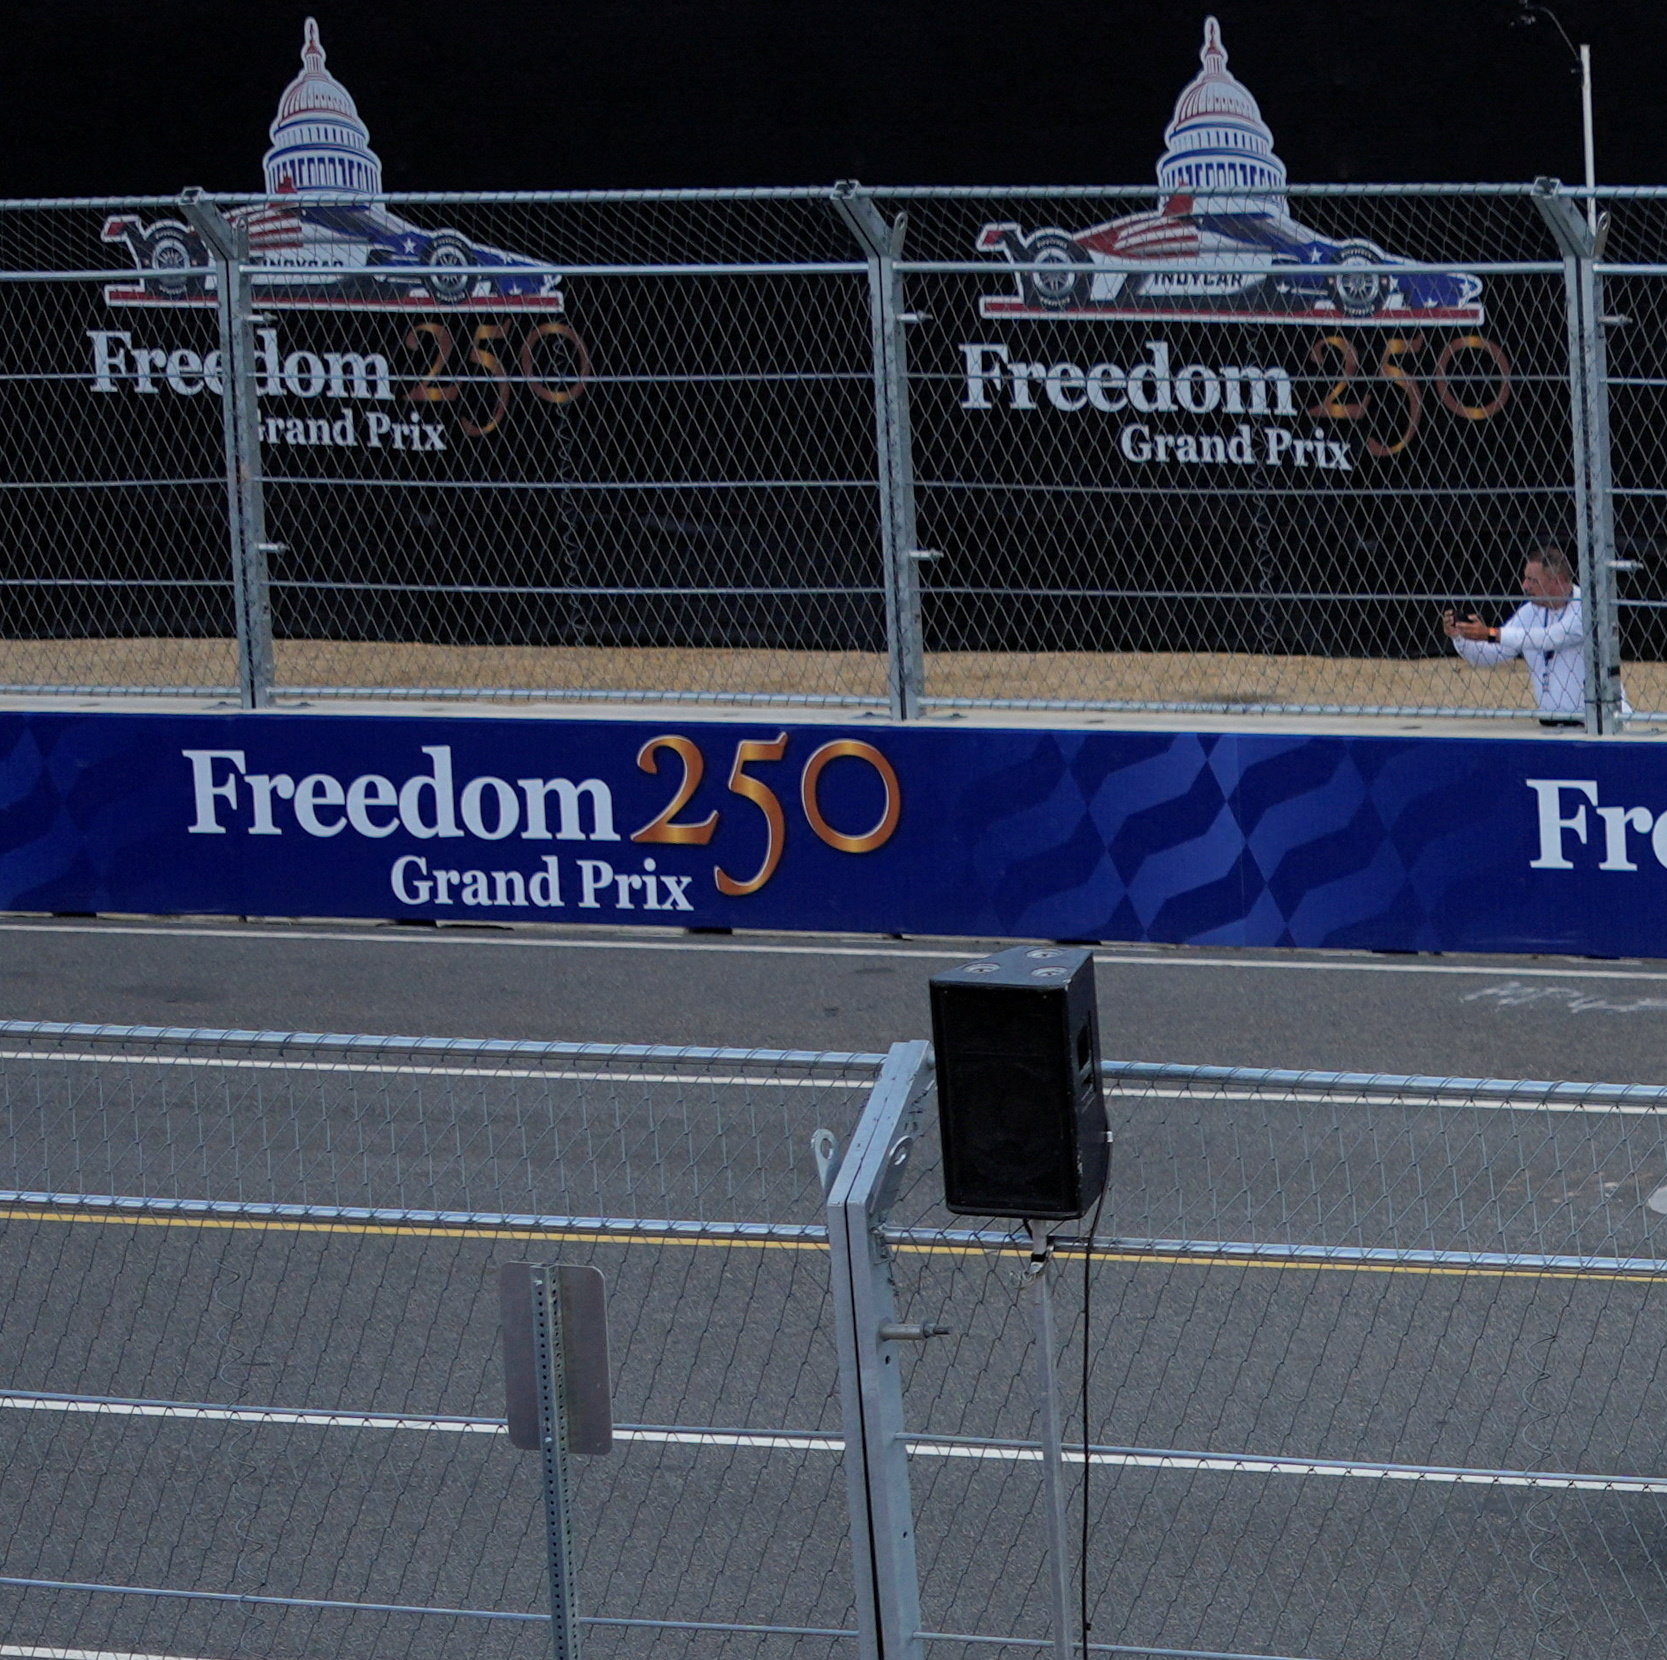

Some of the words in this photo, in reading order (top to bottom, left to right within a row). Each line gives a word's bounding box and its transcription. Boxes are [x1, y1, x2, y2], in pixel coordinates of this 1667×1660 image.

[402, 317, 590, 438] 250
[957, 340, 1298, 417] Freedom
[1307, 332, 1512, 458] 250
[257, 407, 358, 448] rand
[366, 411, 448, 451] Prix
[1120, 422, 1256, 466] Grand
[1264, 426, 1353, 472] Prix
[182, 745, 622, 843] Freedom
[630, 730, 902, 898] 250
[390, 855, 565, 908] Grand
[578, 857, 695, 912] Prix
